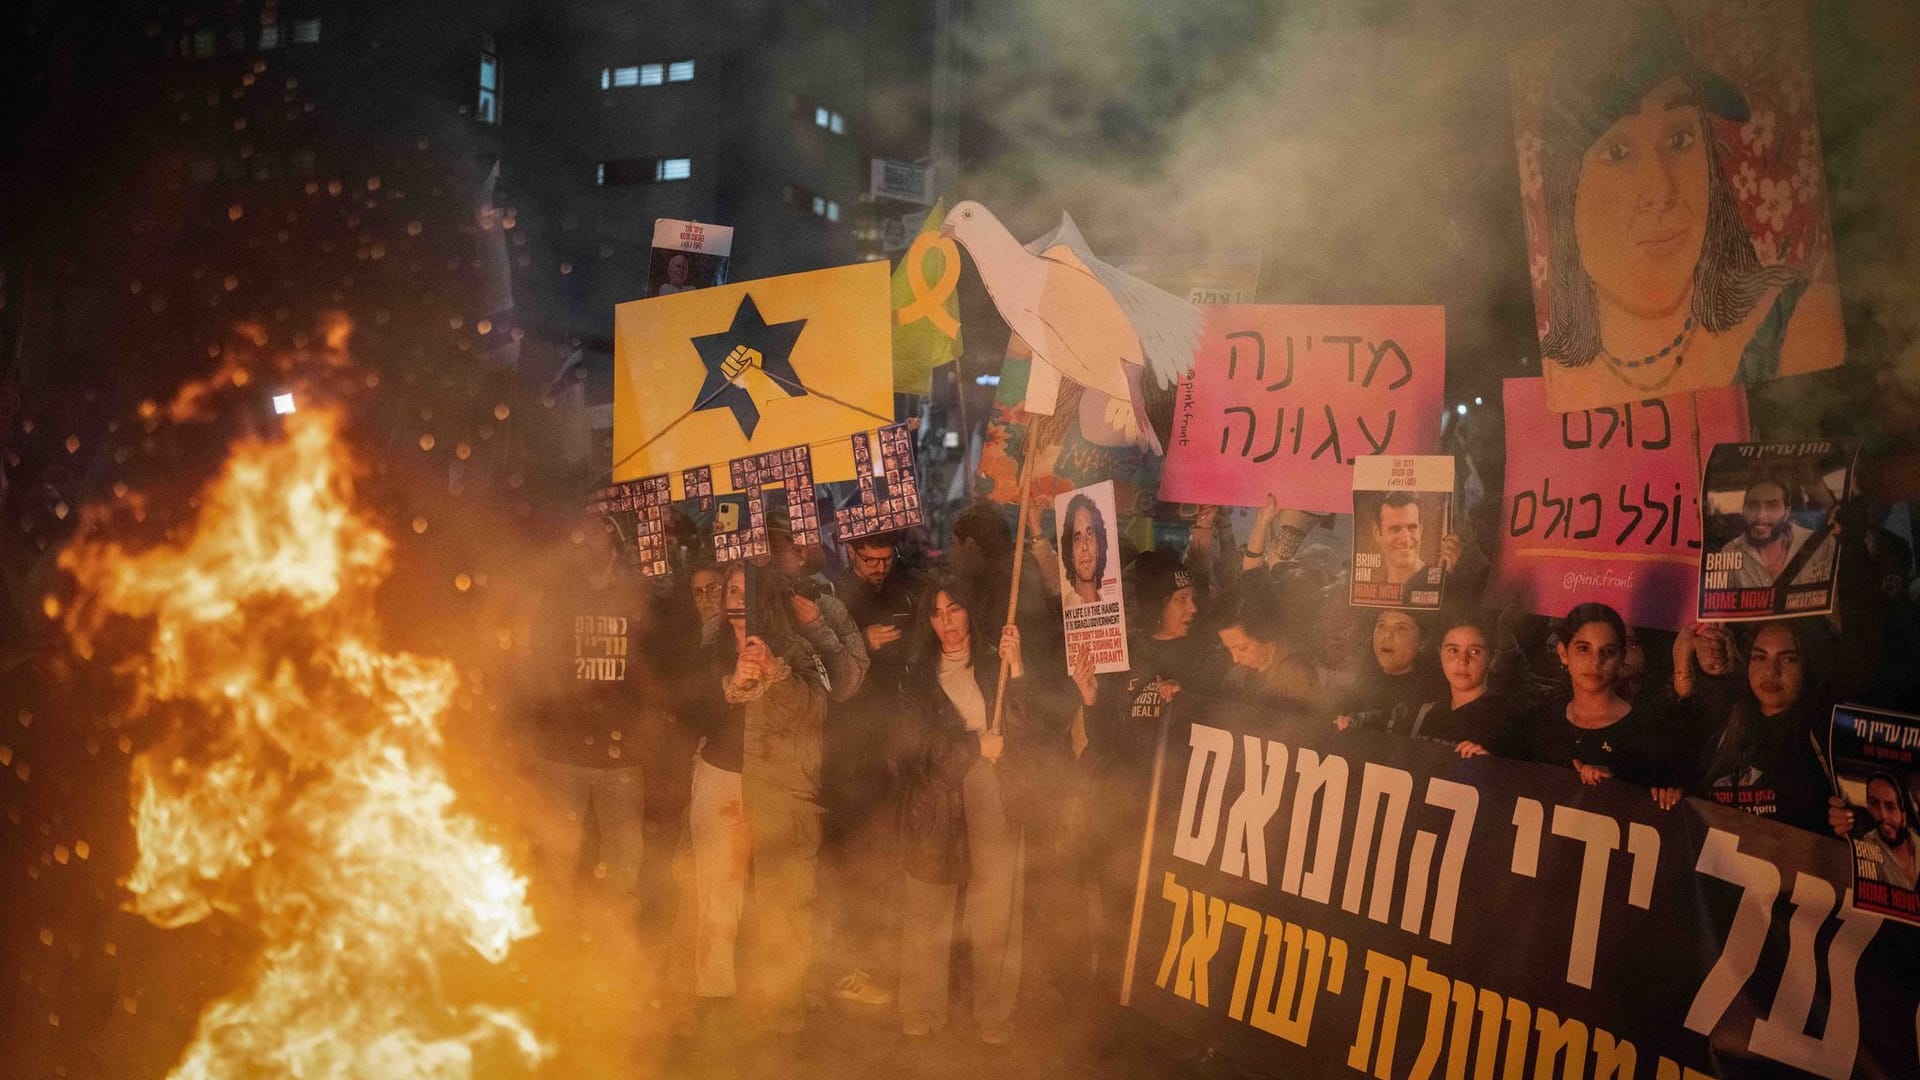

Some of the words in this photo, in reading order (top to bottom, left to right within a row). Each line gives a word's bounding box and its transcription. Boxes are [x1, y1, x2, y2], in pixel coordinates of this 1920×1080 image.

[1225, 330, 1413, 392] מדינה
[1178, 369, 1196, 447] @pink.front
[1355, 552, 1381, 568] BRING
[1706, 551, 1743, 571] BRING
[1354, 567, 1371, 582] HIM
[1563, 571, 1633, 590] @pink.front
[1704, 571, 1728, 589] HIM
[1354, 583, 1378, 598] HOME
[1704, 591, 1737, 609] HOME
[1741, 588, 1775, 609] NOW!
[1065, 609, 1073, 620] MY
[1073, 607, 1083, 618] LIFE
[1091, 605, 1101, 616] THE
[1101, 602, 1120, 614] HANDS
[1090, 614, 1120, 628] GOVERNMENT
[1108, 627, 1121, 637] DEAL
[1068, 642, 1079, 654] THEY
[1093, 639, 1113, 650] SIGNING
[1113, 638, 1122, 649] MY
[1131, 706, 1152, 717] DEAL
[1854, 718, 1867, 738] חי
[1868, 720, 1901, 744] עדיין
[1171, 723, 1480, 945] החמאס
[1853, 839, 1884, 864] BRING
[1857, 858, 1878, 881] HIM
[1512, 797, 1661, 991] ידי
[1858, 879, 1888, 906] HOME
[1155, 871, 1347, 1048] ישראל
